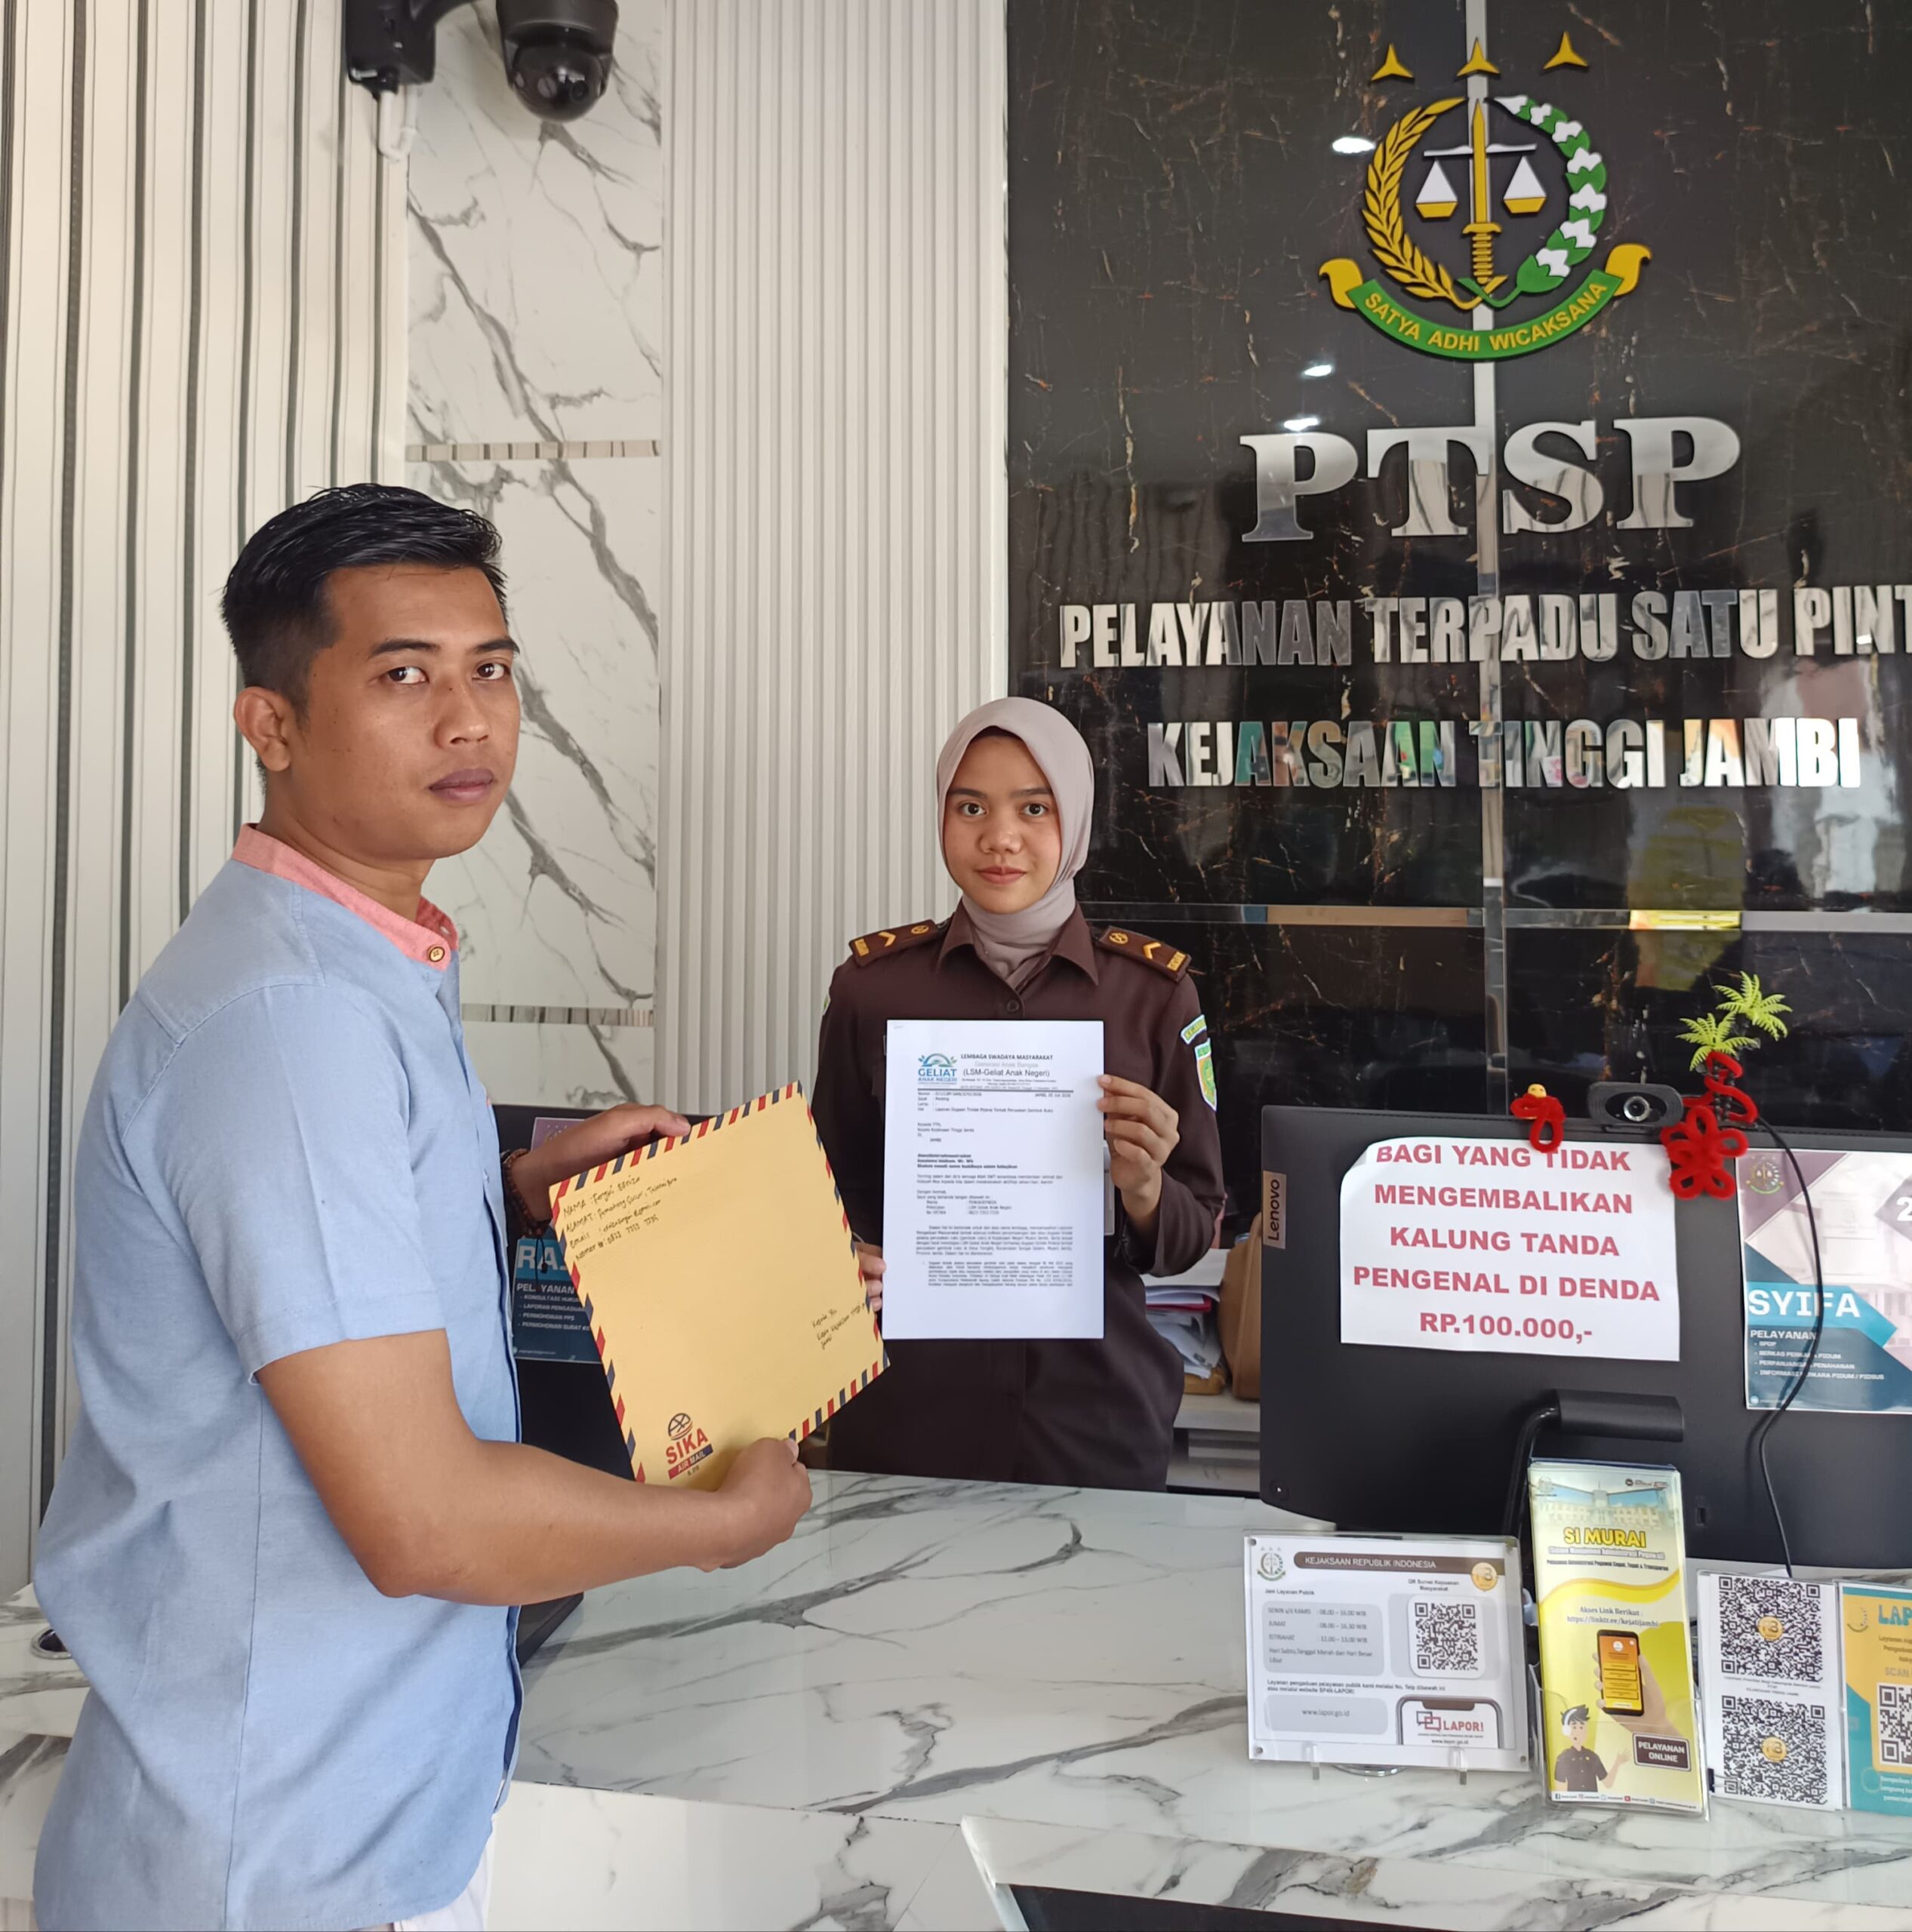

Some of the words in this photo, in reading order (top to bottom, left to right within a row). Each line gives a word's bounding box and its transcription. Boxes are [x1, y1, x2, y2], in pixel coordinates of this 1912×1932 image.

[1364, 291, 1421, 341] SATYA
[1427, 331, 1479, 352] ADHI
[1489, 282, 1609, 351] WICAKSANA
[1239, 416, 1741, 542] PTSP
[1059, 600, 1352, 668] PELAYANAN
[1365, 592, 1618, 664] TERPADU
[1630, 589, 1778, 660] SATU
[1147, 720, 1457, 789] KEJAKSAAN
[1468, 719, 1666, 789] TINGGI
[1680, 717, 1861, 789] JAMBI
[918, 1069, 957, 1077] GELIAT
[1024, 1069, 1050, 1078] Negeri)
[1375, 1143, 1442, 1164] BAGI
[1452, 1145, 1531, 1168] YANG
[1542, 1148, 1631, 1171] TIDAK
[562, 1199, 586, 1218] NAMA
[1267, 1179, 1280, 1241] Lenovo
[1375, 1183, 1633, 1214] MENGEMBALIKAN
[565, 1213, 593, 1232] ALAMAT
[1390, 1226, 1510, 1251] KALUNG
[1520, 1232, 1620, 1257] TANDA
[516, 1283, 575, 1294] PELYANAN
[1353, 1266, 1510, 1294] PENGENAL
[1519, 1275, 1547, 1296] DI
[1559, 1277, 1660, 1302] DENDA
[1419, 1312, 1593, 1345] RP.100.000,-
[1750, 1330, 1817, 1340] PELAYANAN
[666, 1427, 708, 1464] SIKA
[1563, 1526, 1581, 1546] SI
[1584, 1528, 1647, 1549] MURAI
[1304, 1556, 1351, 1566] KEJAKSAAN
[1352, 1558, 1391, 1567] REPUBLIK
[1393, 1559, 1436, 1569] INDONESIA
[1302, 1708, 1350, 1718] www.lapor.go.id
[1443, 1720, 1484, 1732] LAPOR!
[1638, 1741, 1685, 1754] PELAYANAN
[1648, 1752, 1678, 1763] ONLINE
